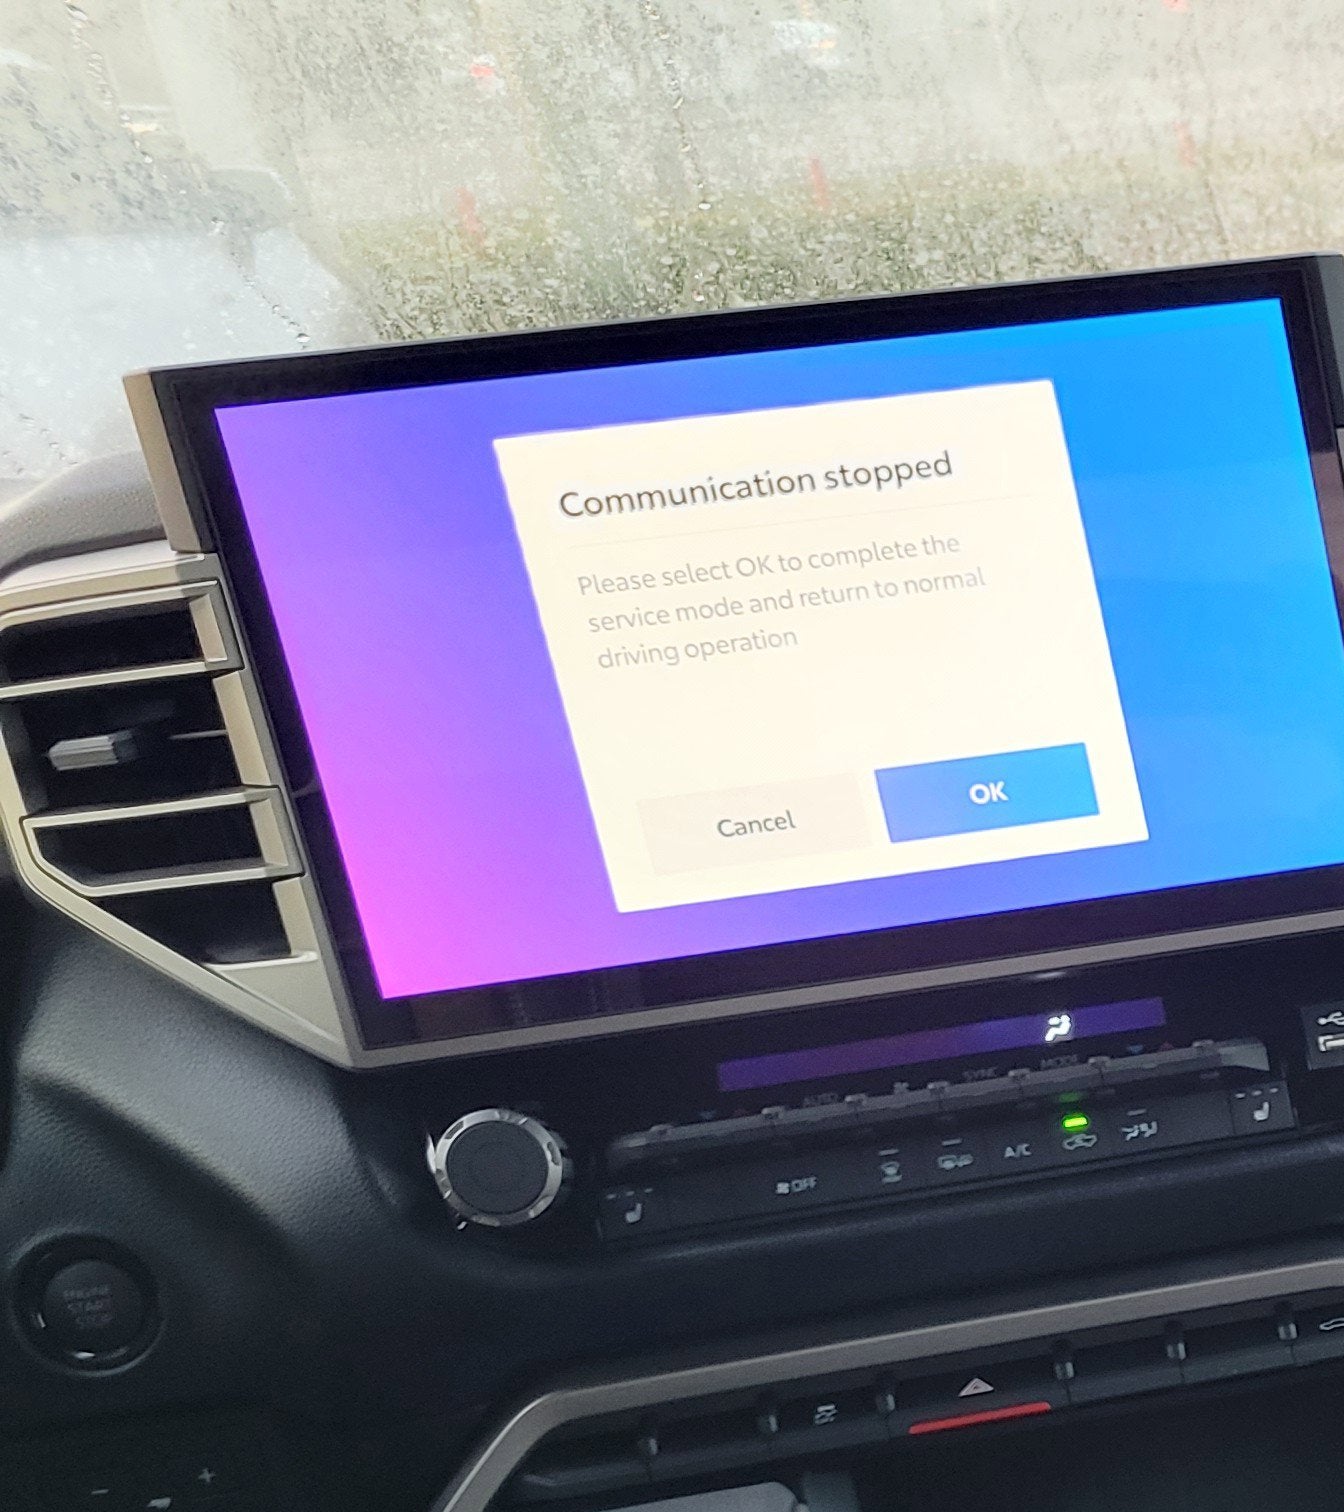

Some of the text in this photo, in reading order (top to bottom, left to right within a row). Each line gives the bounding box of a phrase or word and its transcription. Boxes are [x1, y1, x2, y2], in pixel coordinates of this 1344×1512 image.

[558, 450, 953, 519] Communication stopped
[577, 532, 960, 596] Please select OK to complete the
[587, 565, 986, 634] service mode and return to normal
[597, 625, 798, 670] driving operation
[968, 780, 1008, 806] OK
[716, 809, 796, 838] Cancel
[1003, 1142, 1032, 1159] A/C
[790, 1175, 818, 1193] OFF
